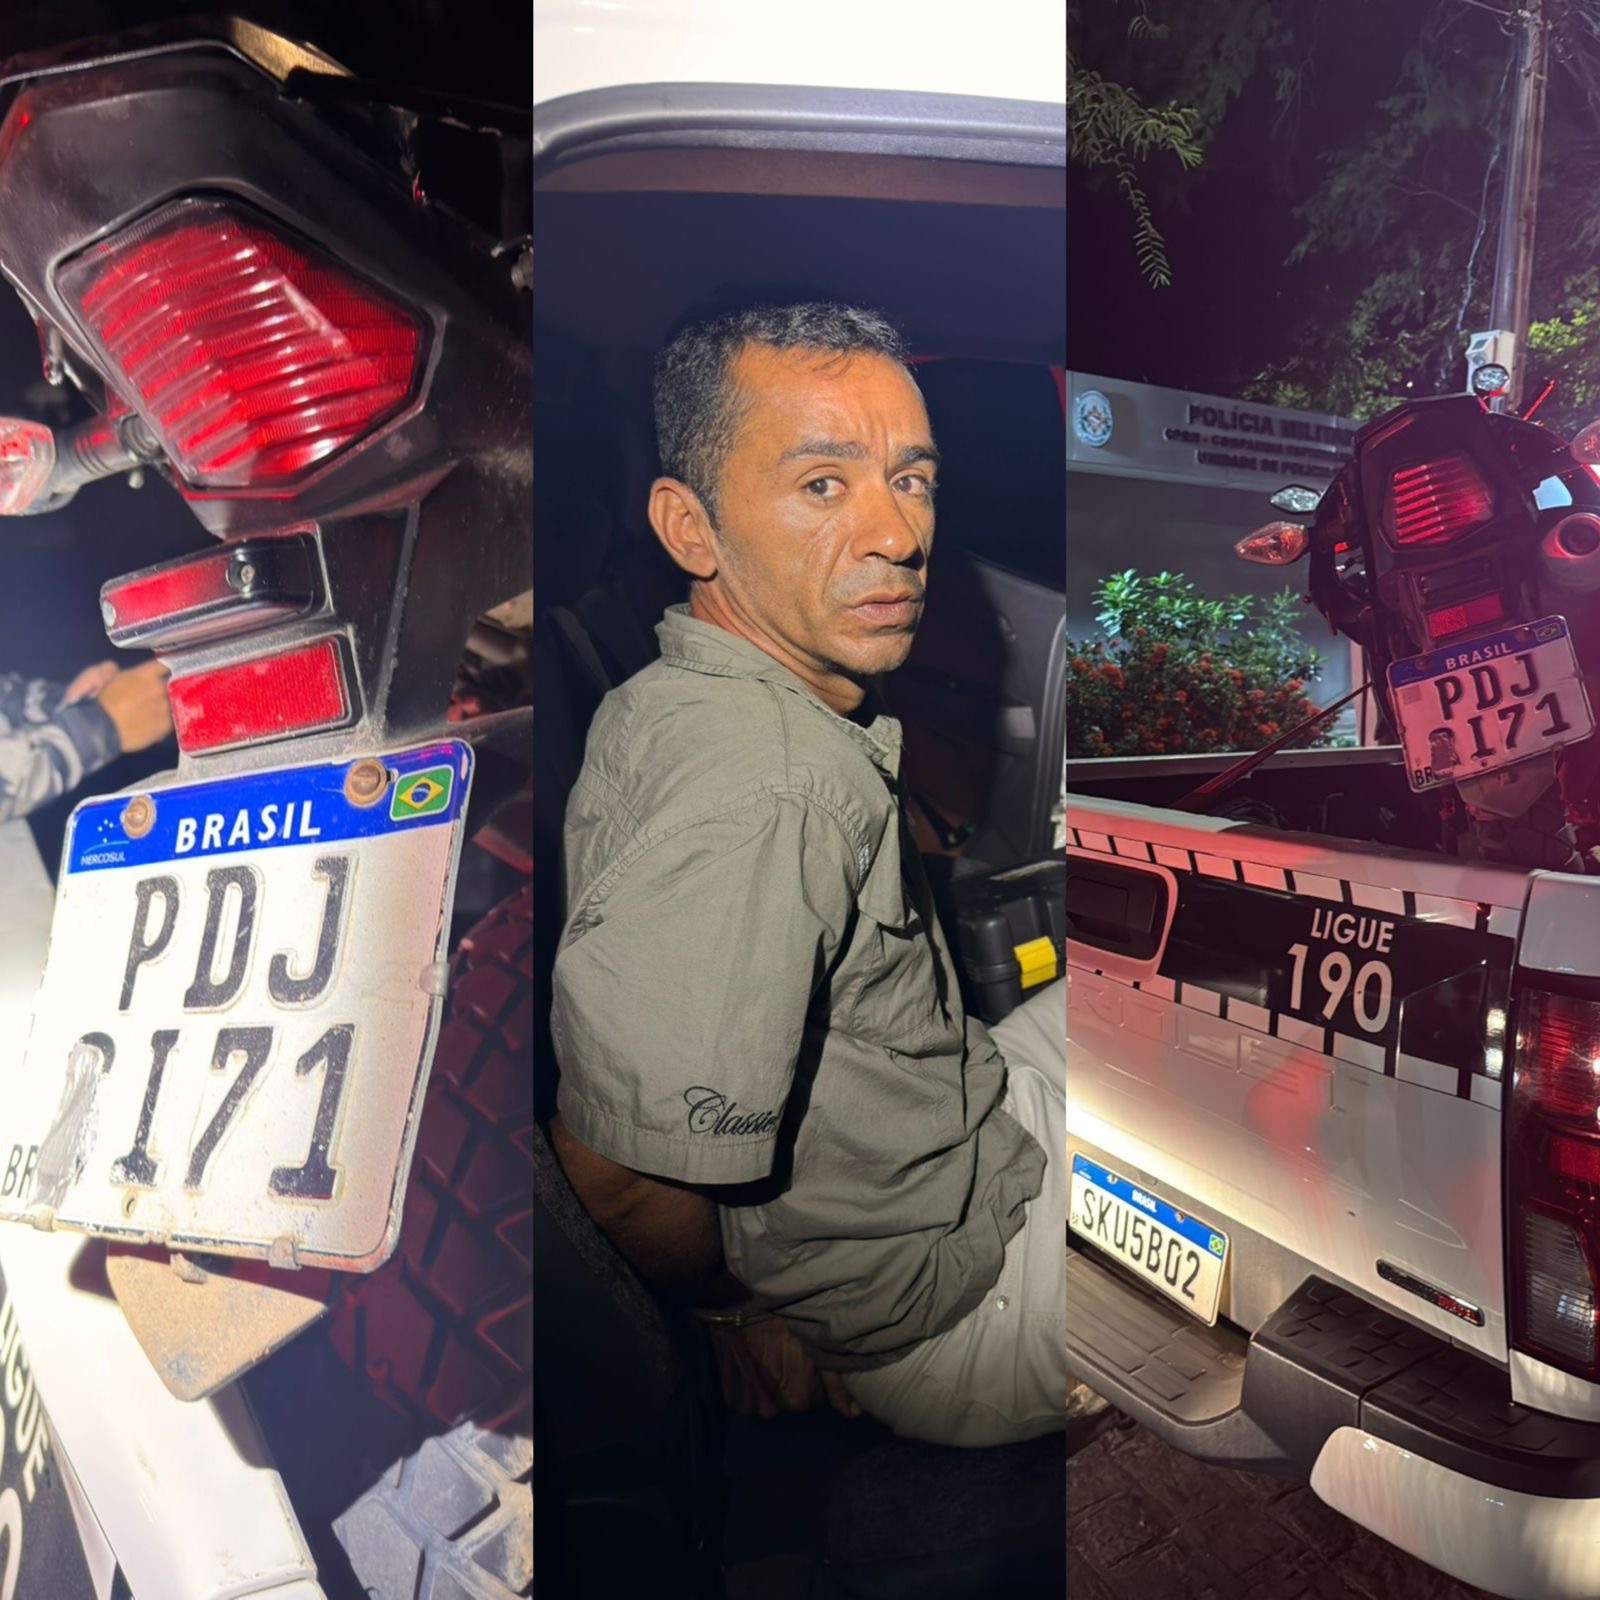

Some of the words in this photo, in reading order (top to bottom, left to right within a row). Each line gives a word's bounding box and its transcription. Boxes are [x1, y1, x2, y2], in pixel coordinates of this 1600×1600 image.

[1187, 403, 1275, 437] POLÍCIA
[1445, 642, 1511, 670] BRASIL
[1434, 654, 1538, 720] PDJ
[175, 800, 321, 854] BRASIL
[80, 852, 126, 865] MERCOSUL
[118, 856, 351, 1011] PDJ
[1310, 907, 1395, 953] LIGUE
[1287, 943, 1393, 1033] 190
[1082, 1187, 1201, 1301] SKU5B02
